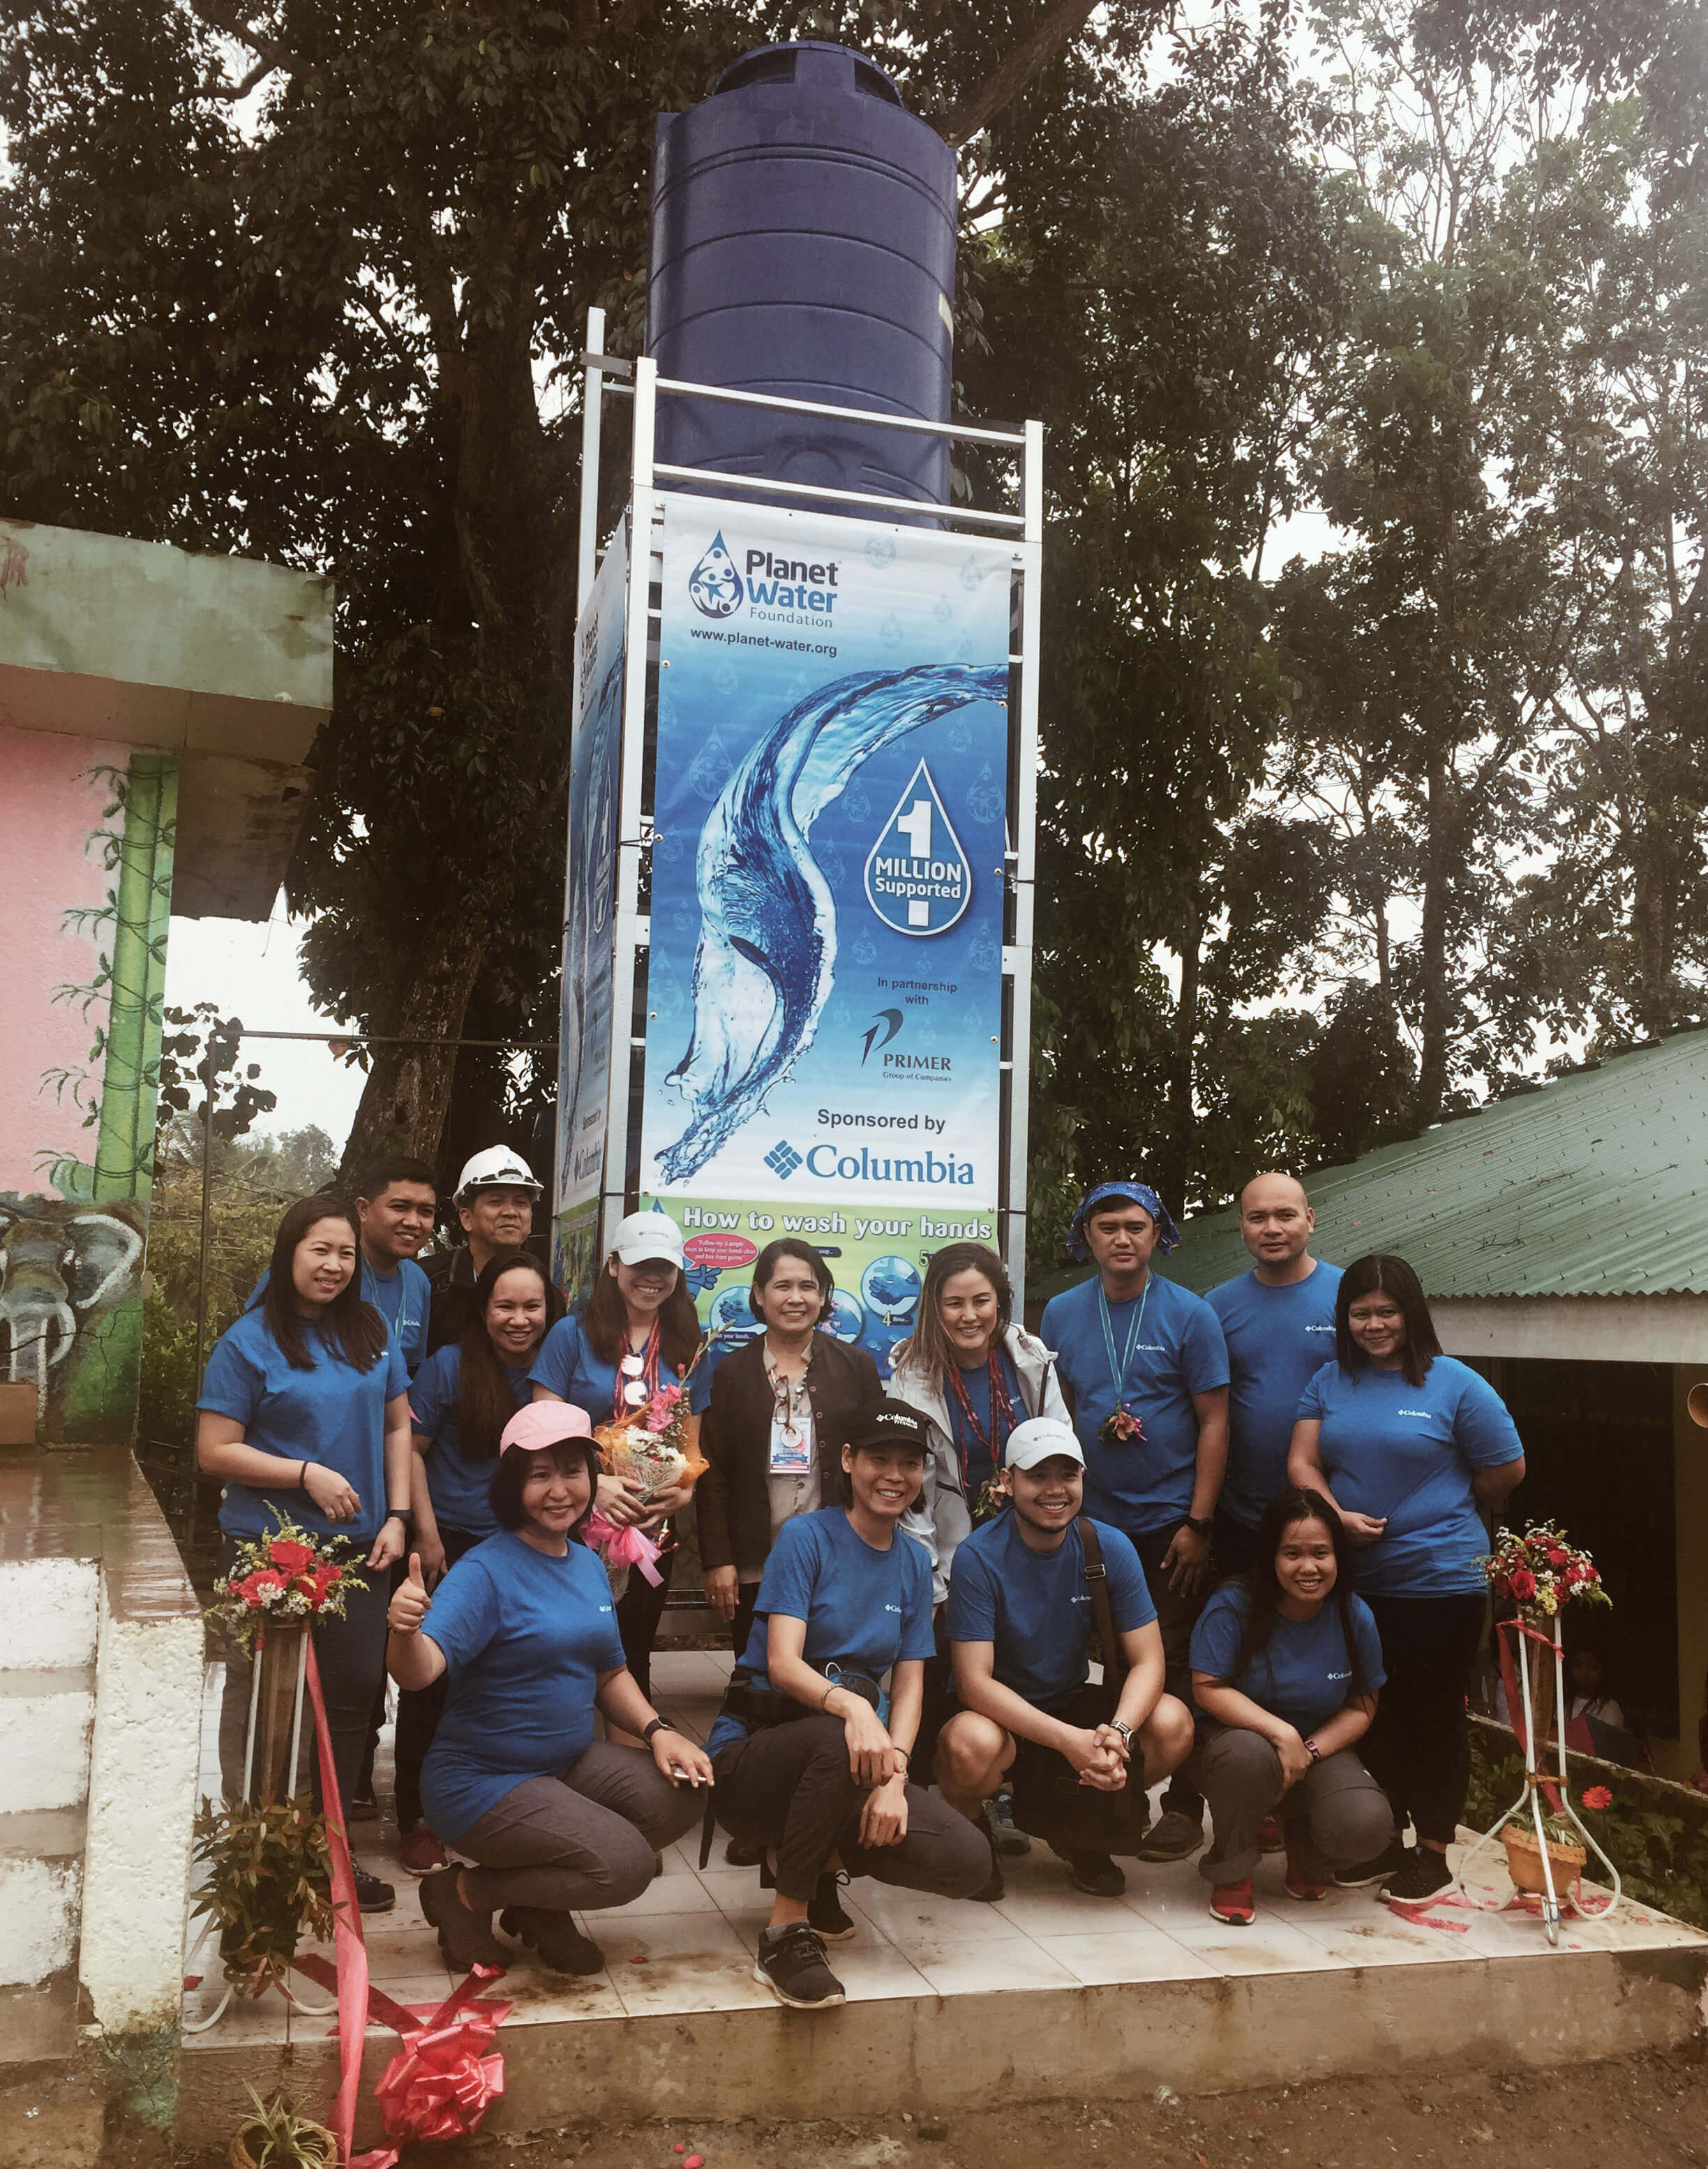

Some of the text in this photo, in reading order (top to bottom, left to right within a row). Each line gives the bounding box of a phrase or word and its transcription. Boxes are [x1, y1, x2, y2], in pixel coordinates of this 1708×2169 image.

[746, 549, 839, 586] Planet
[746, 577, 838, 613] Water
[749, 607, 832, 628] Foundation
[691, 629, 837, 658] www.planet-water.org
[876, 856, 961, 882] MILLION
[875, 877, 961, 899] Supported
[878, 977, 958, 994] In partnership
[905, 994, 929, 1005] with
[883, 1054, 952, 1071] PRIMER
[883, 1071, 905, 1080] Group
[818, 1109, 945, 1135] Sponsored by
[806, 1145, 975, 1185] Columbia
[683, 1206, 992, 1240] How to wash your hands
[919, 1249, 929, 1267] 5
[882, 1310, 892, 1327] 4
